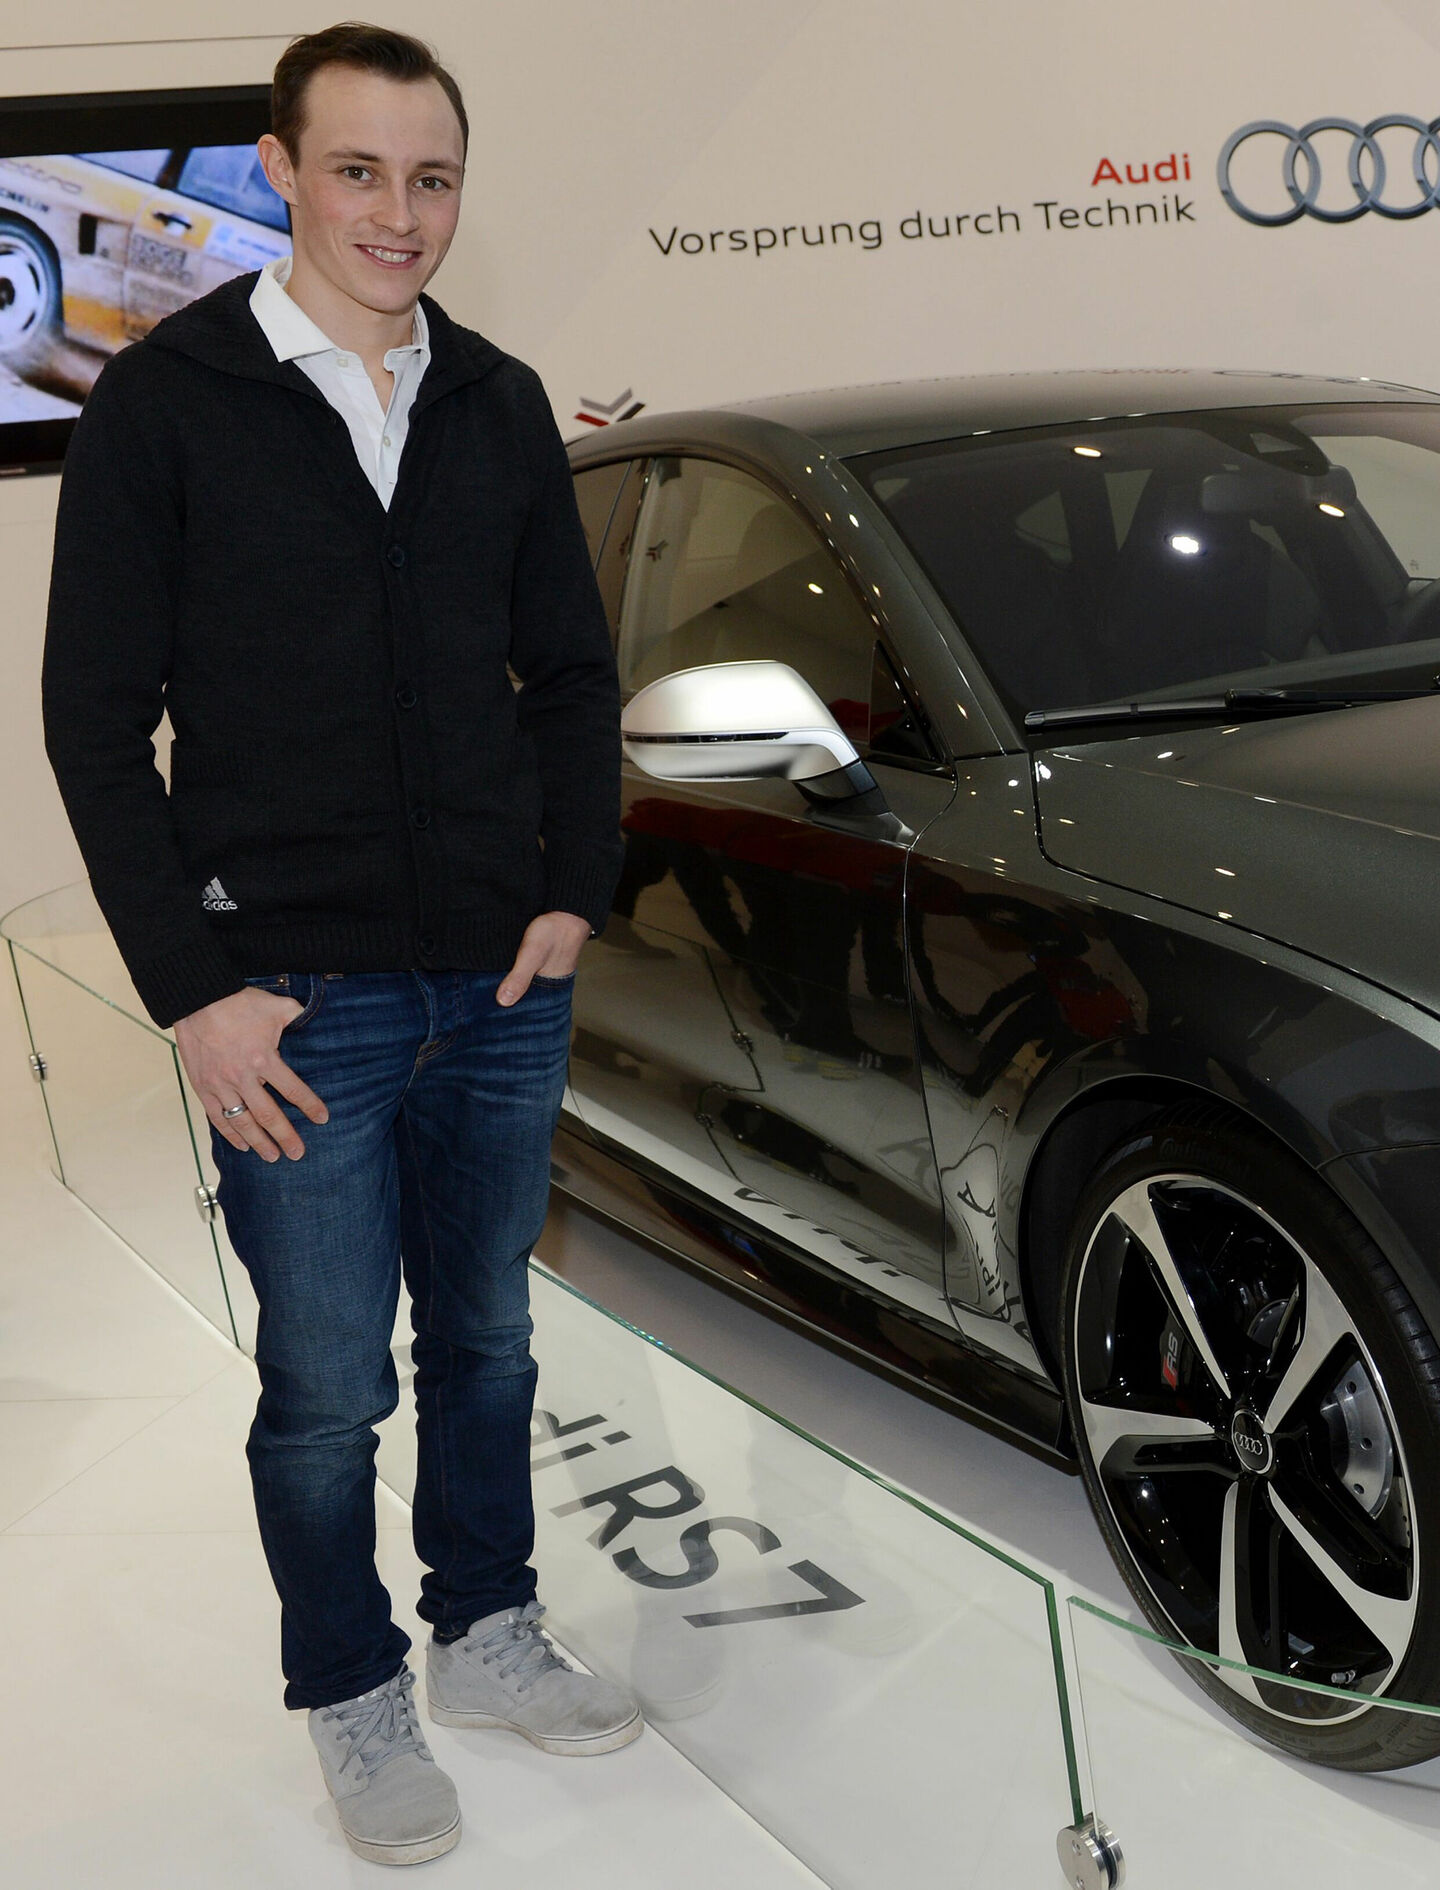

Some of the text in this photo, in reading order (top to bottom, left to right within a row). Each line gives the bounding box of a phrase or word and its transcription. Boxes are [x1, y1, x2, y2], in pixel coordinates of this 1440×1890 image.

[1091, 153, 1191, 187] Audi
[649, 194, 1196, 257] Vorsprung durch Technik
[202, 899, 238, 911] didas
